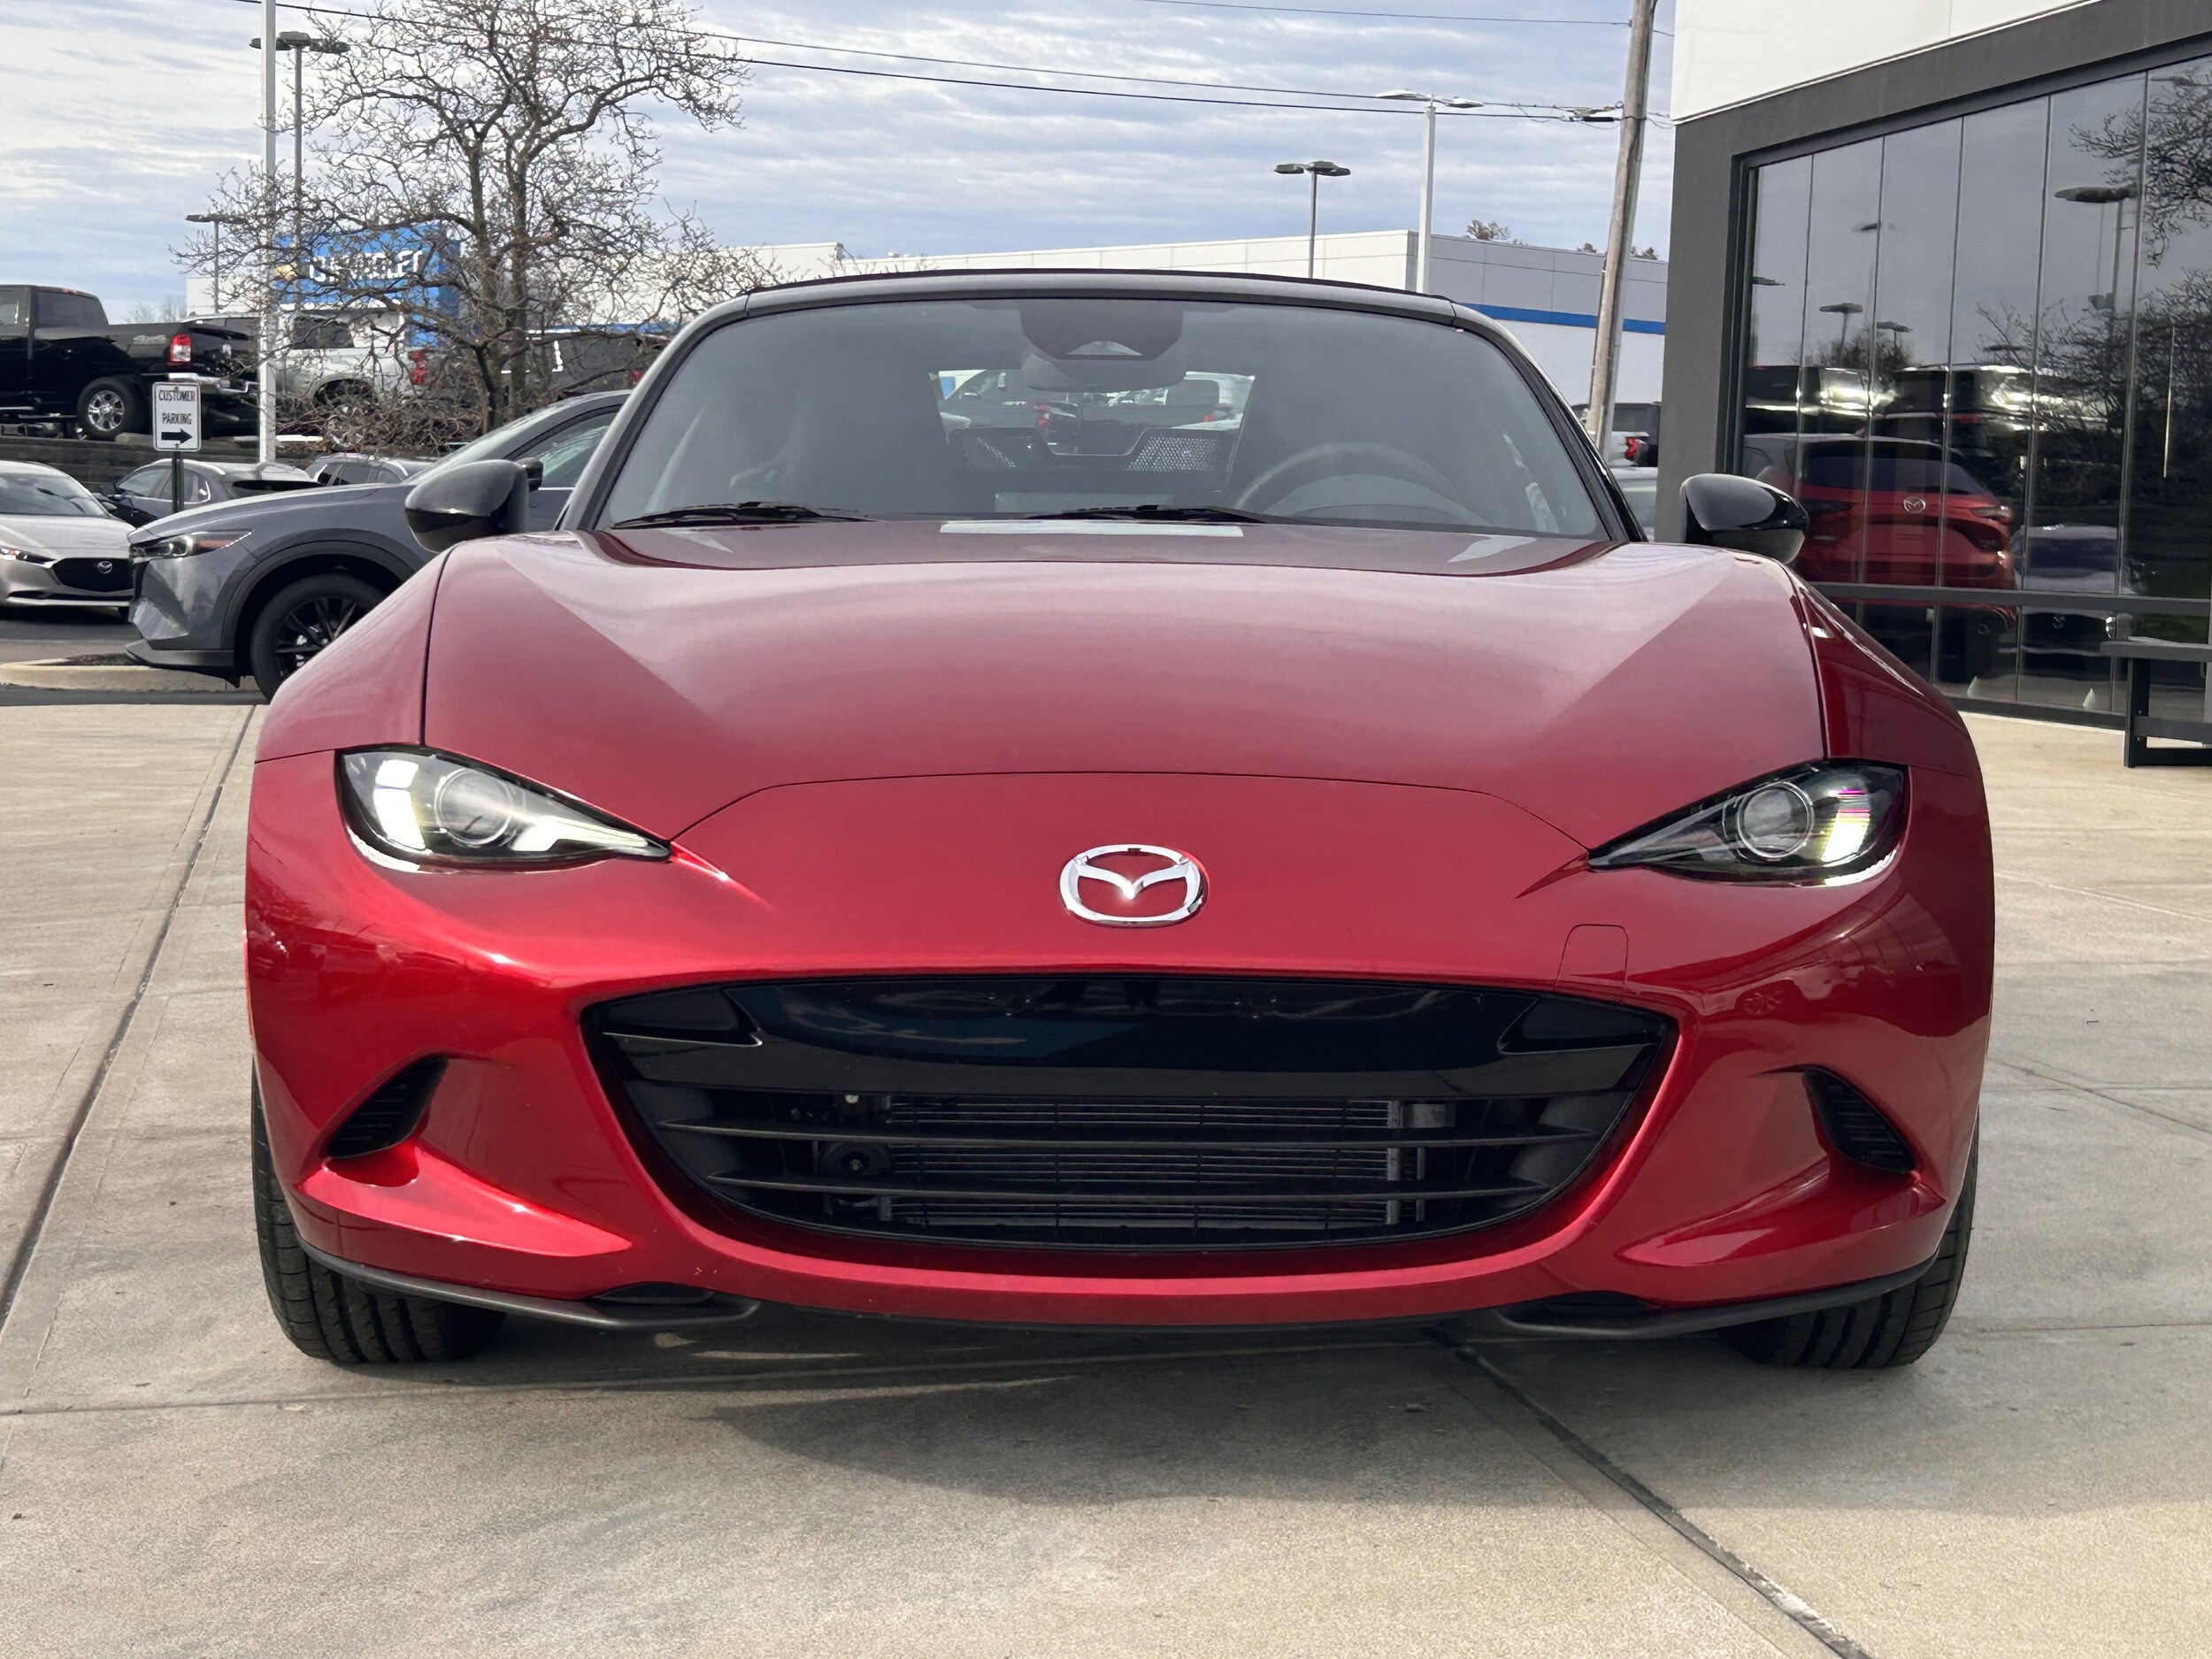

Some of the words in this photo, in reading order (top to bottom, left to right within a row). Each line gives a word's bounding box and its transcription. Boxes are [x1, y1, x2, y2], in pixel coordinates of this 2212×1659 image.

[310, 250, 423, 282] CROLET
[159, 390, 196, 401] CUSTOMER
[162, 412, 192, 425] PARKING
